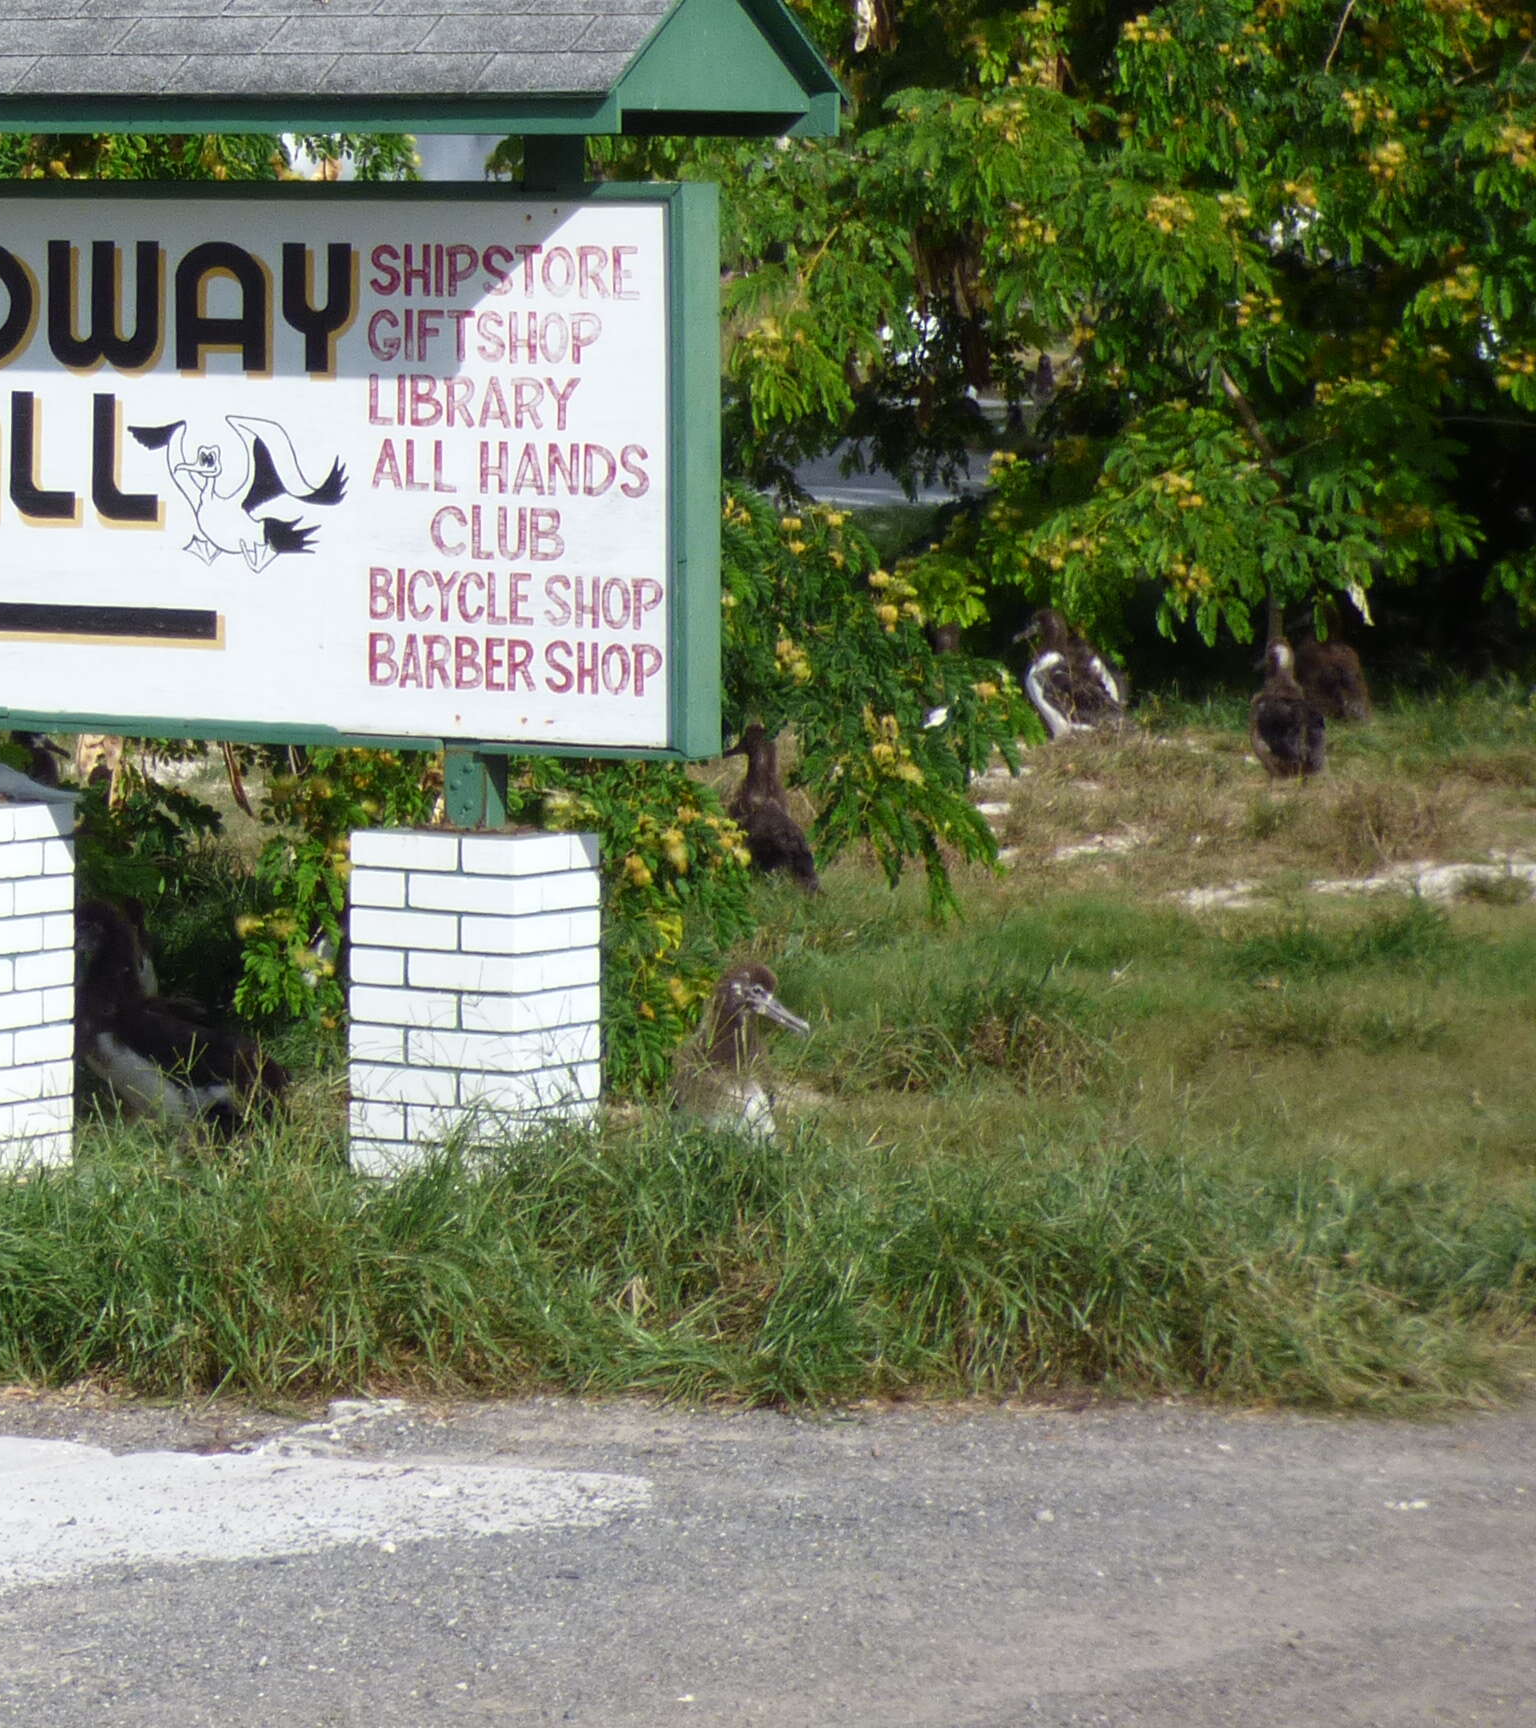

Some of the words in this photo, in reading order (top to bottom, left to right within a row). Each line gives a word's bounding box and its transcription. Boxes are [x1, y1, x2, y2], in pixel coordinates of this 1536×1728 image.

[369, 243, 640, 301] SHIPSTORE
[368, 373, 581, 431] LIBRARY
[371, 438, 458, 493] ALL
[479, 441, 650, 498] HANDS
[430, 504, 565, 561] CLUB
[369, 567, 534, 626] BICYCLE
[543, 574, 664, 631] SHOP
[368, 632, 536, 692] BARBER
[544, 640, 664, 697] SHOP
